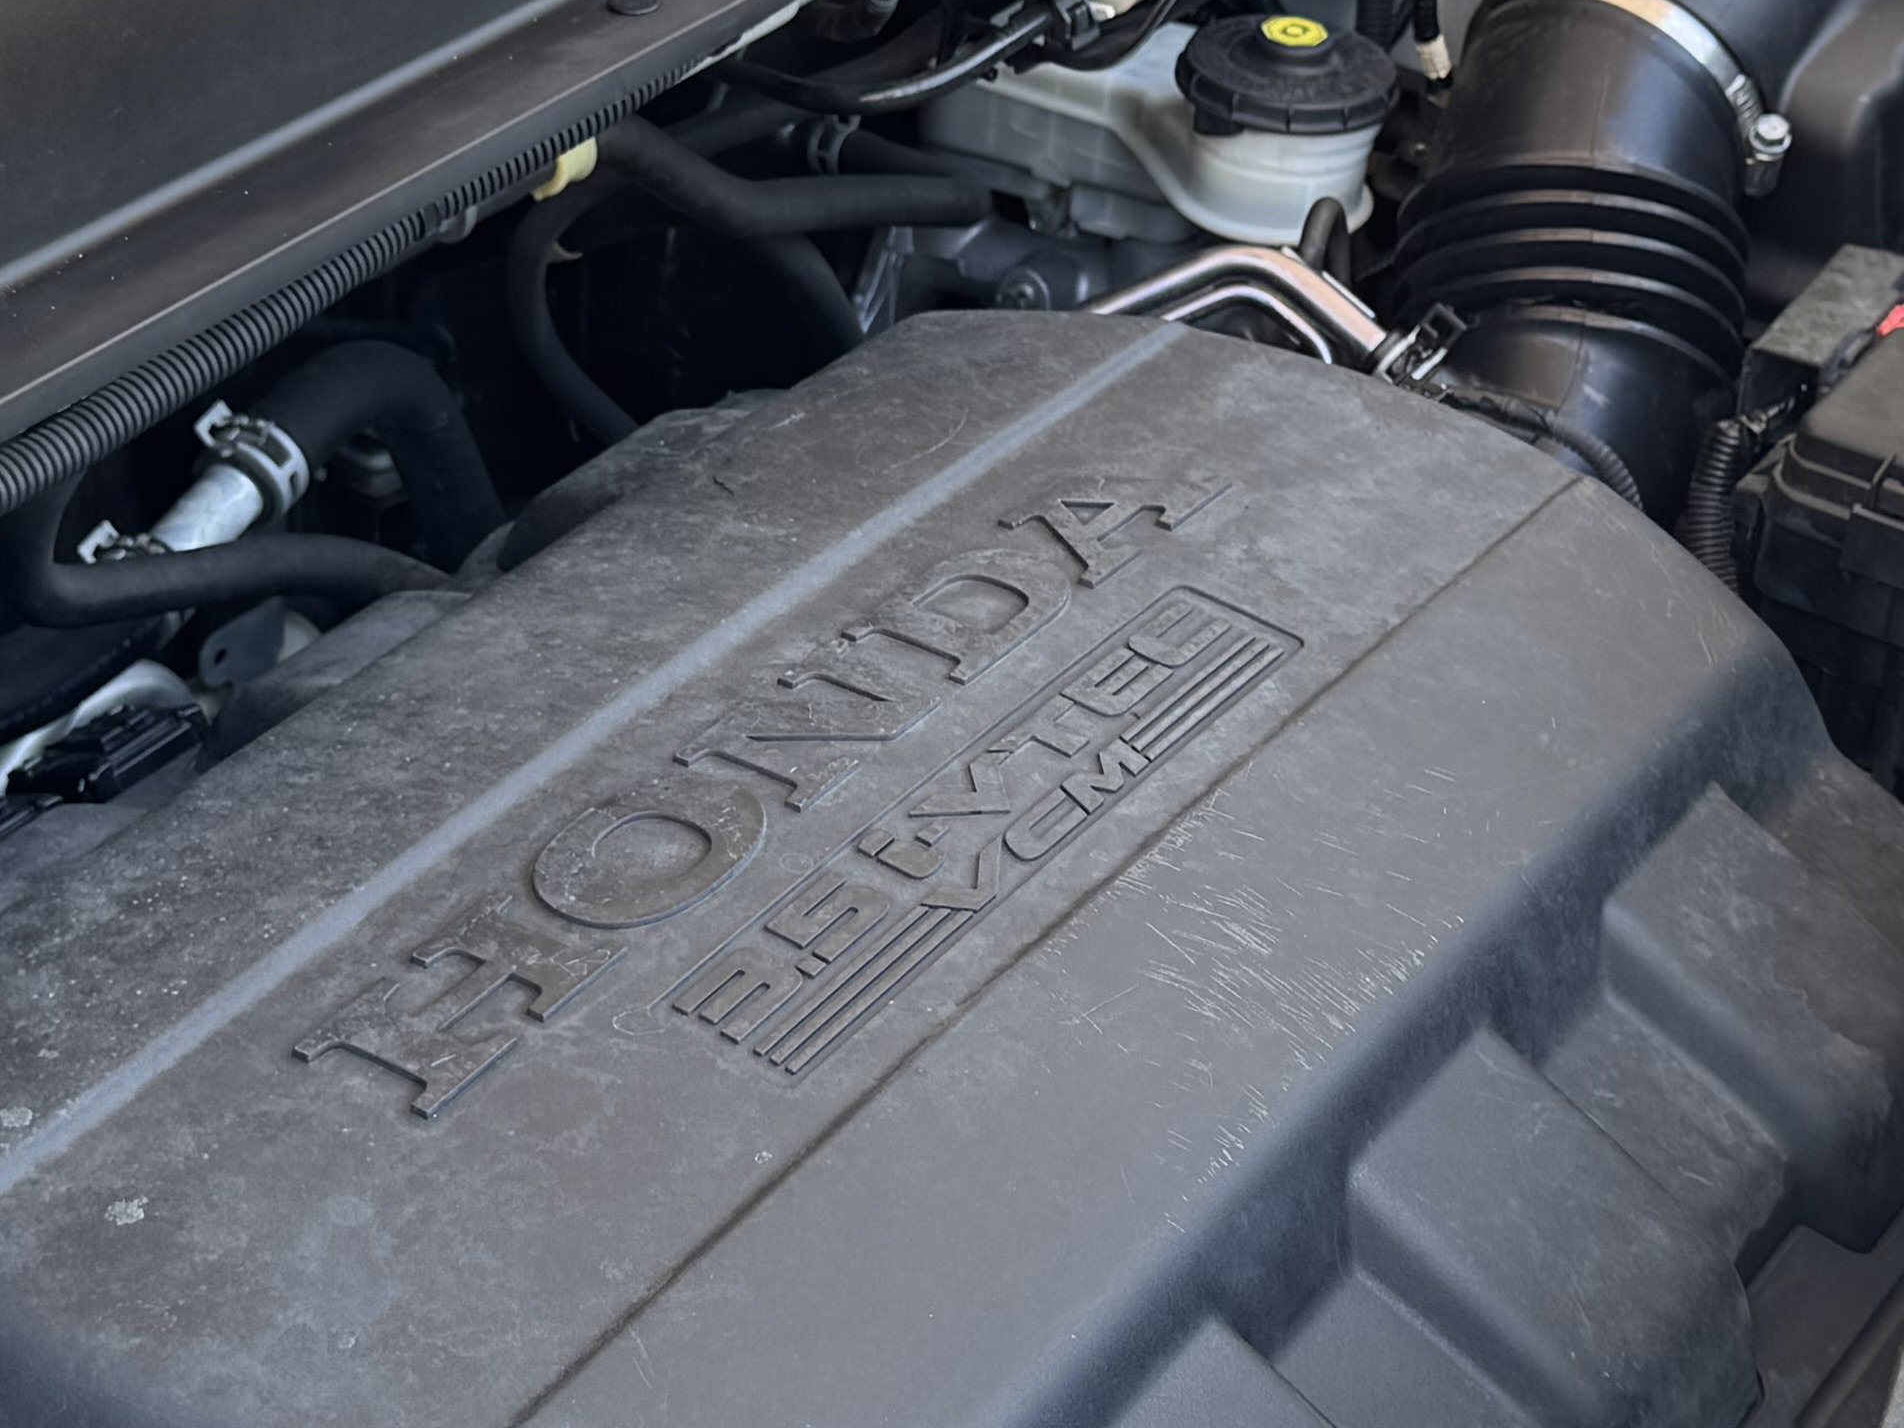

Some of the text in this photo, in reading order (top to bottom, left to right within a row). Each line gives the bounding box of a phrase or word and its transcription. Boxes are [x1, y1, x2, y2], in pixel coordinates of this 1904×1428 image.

[294, 481, 1235, 1118] HONDA
[926, 737, 1152, 912] VCM
[671, 878, 890, 1044] 3.5
